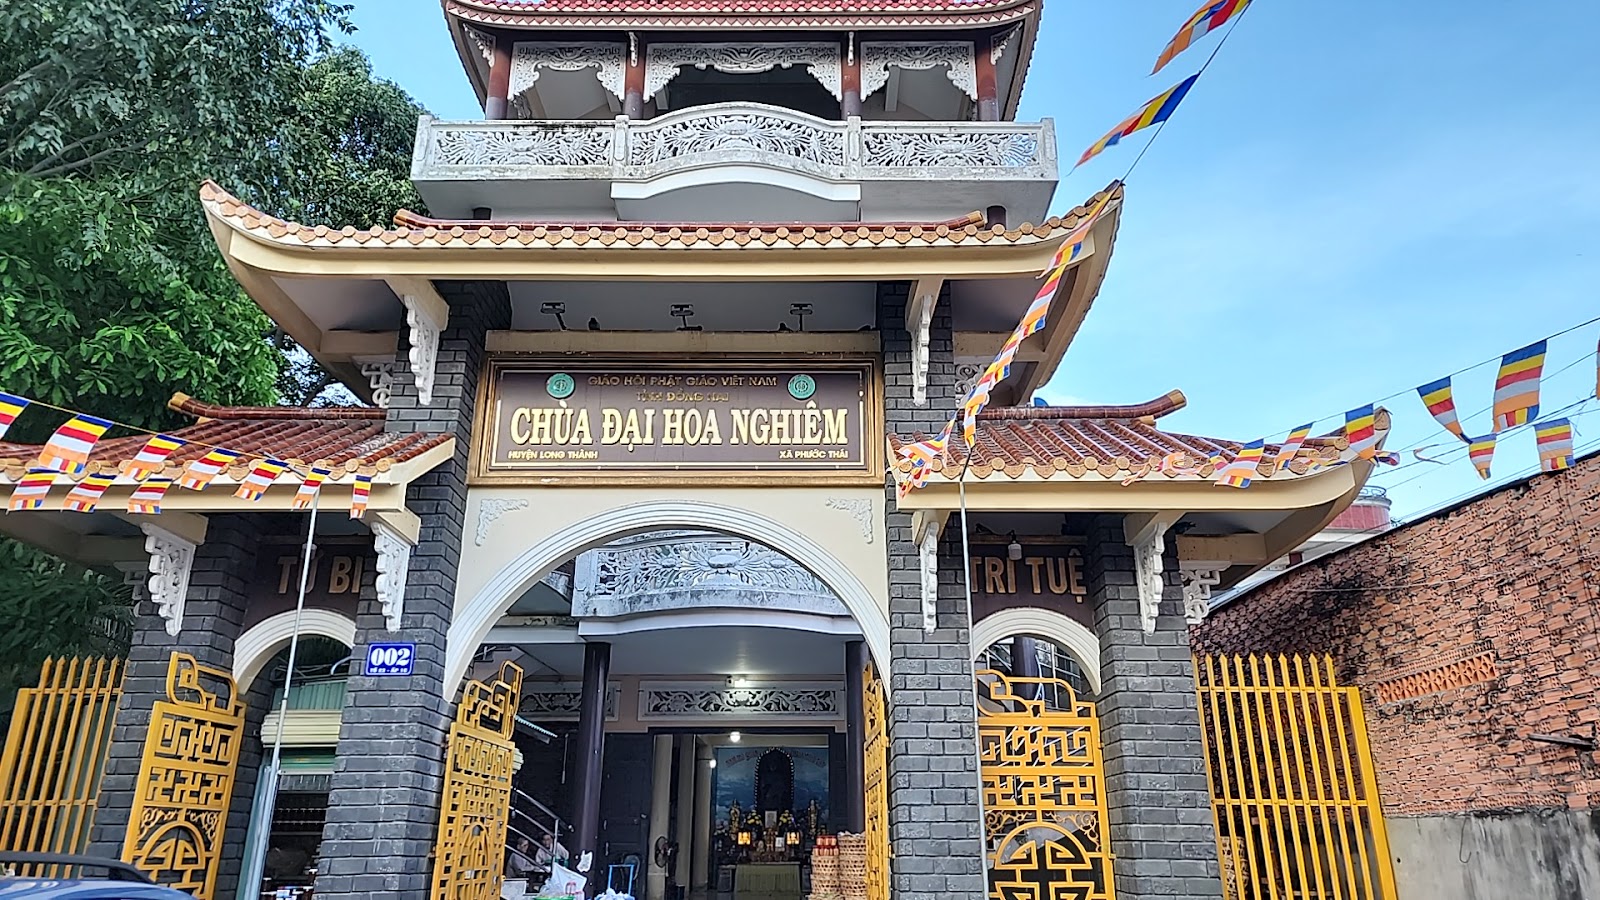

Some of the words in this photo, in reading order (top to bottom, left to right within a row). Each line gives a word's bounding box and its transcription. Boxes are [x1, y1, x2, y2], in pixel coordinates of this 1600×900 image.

[588, 374, 620, 386] GIÁO
[650, 375, 682, 388] PHẬT
[686, 374, 718, 386] GIÁO
[748, 376, 777, 386] NAM
[666, 388, 704, 401] ĐỒNG
[707, 392, 729, 401] NAI
[511, 399, 594, 446] CHÙA
[601, 408, 656, 453] ĐẠI
[662, 408, 722, 446] HOA
[730, 400, 848, 446] NGHIÊM
[508, 449, 538, 460] HUYỆN
[540, 451, 565, 459] LONG
[568, 449, 598, 459] THÀNH
[779, 450, 793, 459] XÃ
[795, 449, 826, 459] PHƯỚC
[828, 449, 849, 459] THÁI
[328, 556, 363, 593] BI
[1025, 548, 1087, 603] TUỆ
[370, 648, 410, 666] 002
